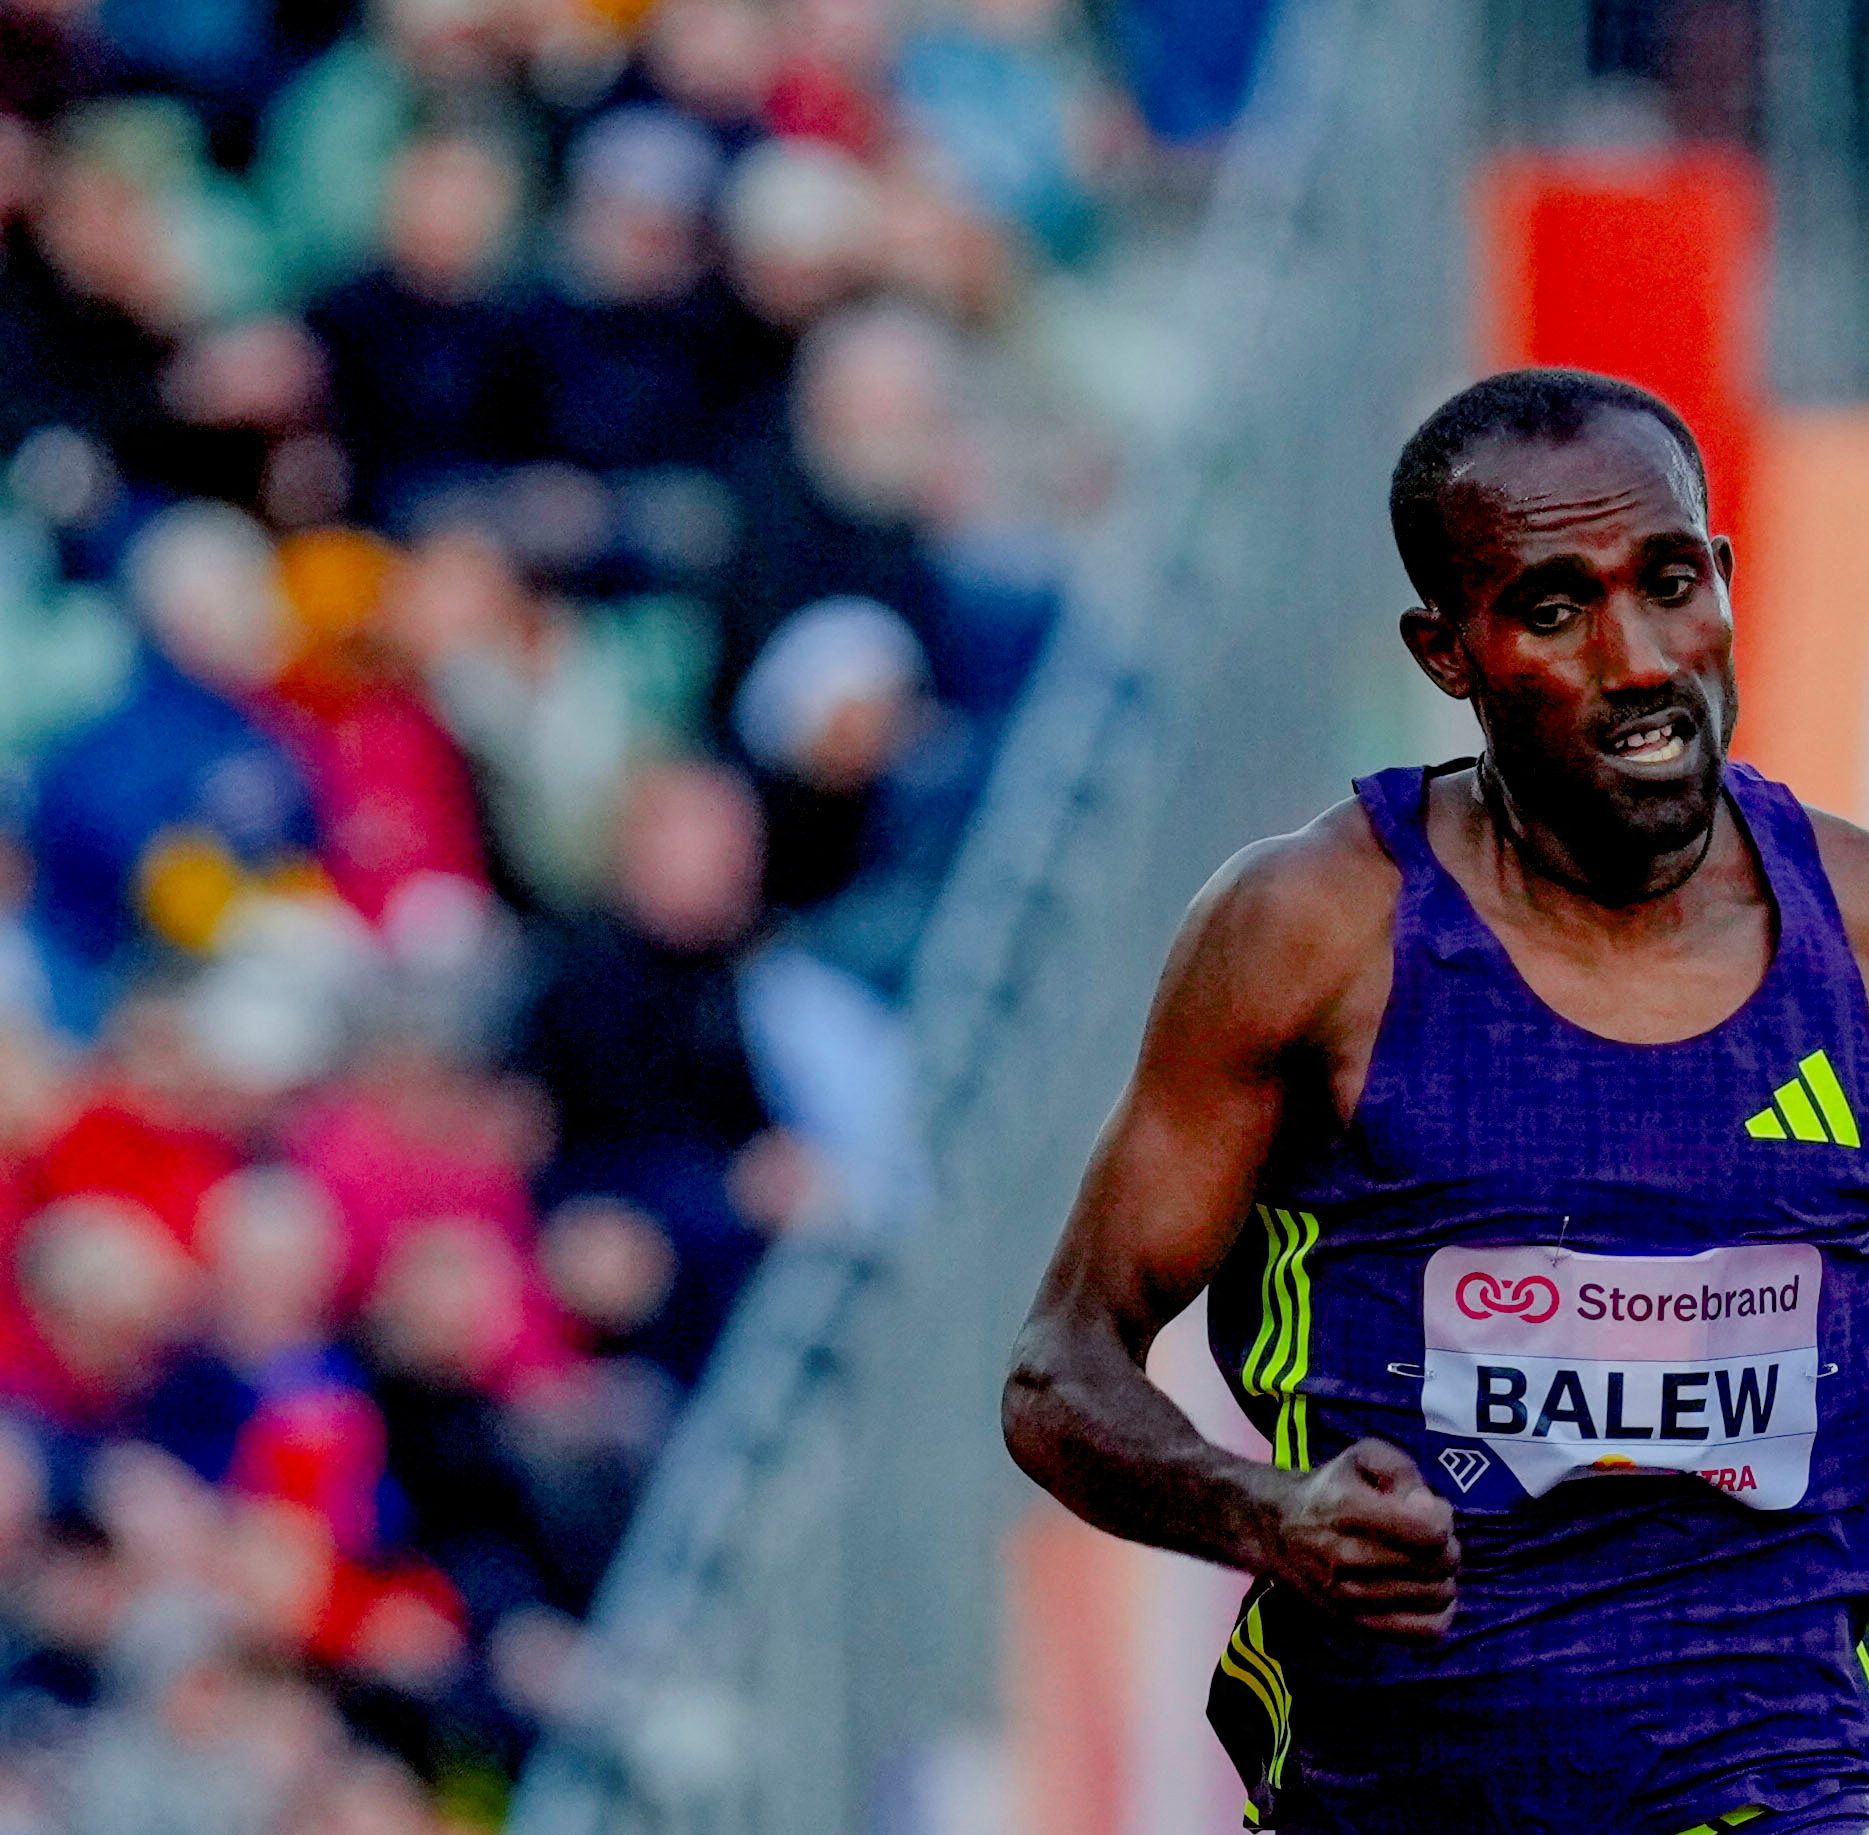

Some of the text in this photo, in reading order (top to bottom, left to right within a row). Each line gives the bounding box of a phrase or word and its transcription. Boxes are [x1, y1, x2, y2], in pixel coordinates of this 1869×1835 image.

[1577, 1275, 1800, 1322] Storebrand
[1475, 1364, 1779, 1440] BALEW
[1684, 1465, 1758, 1492] TRA
